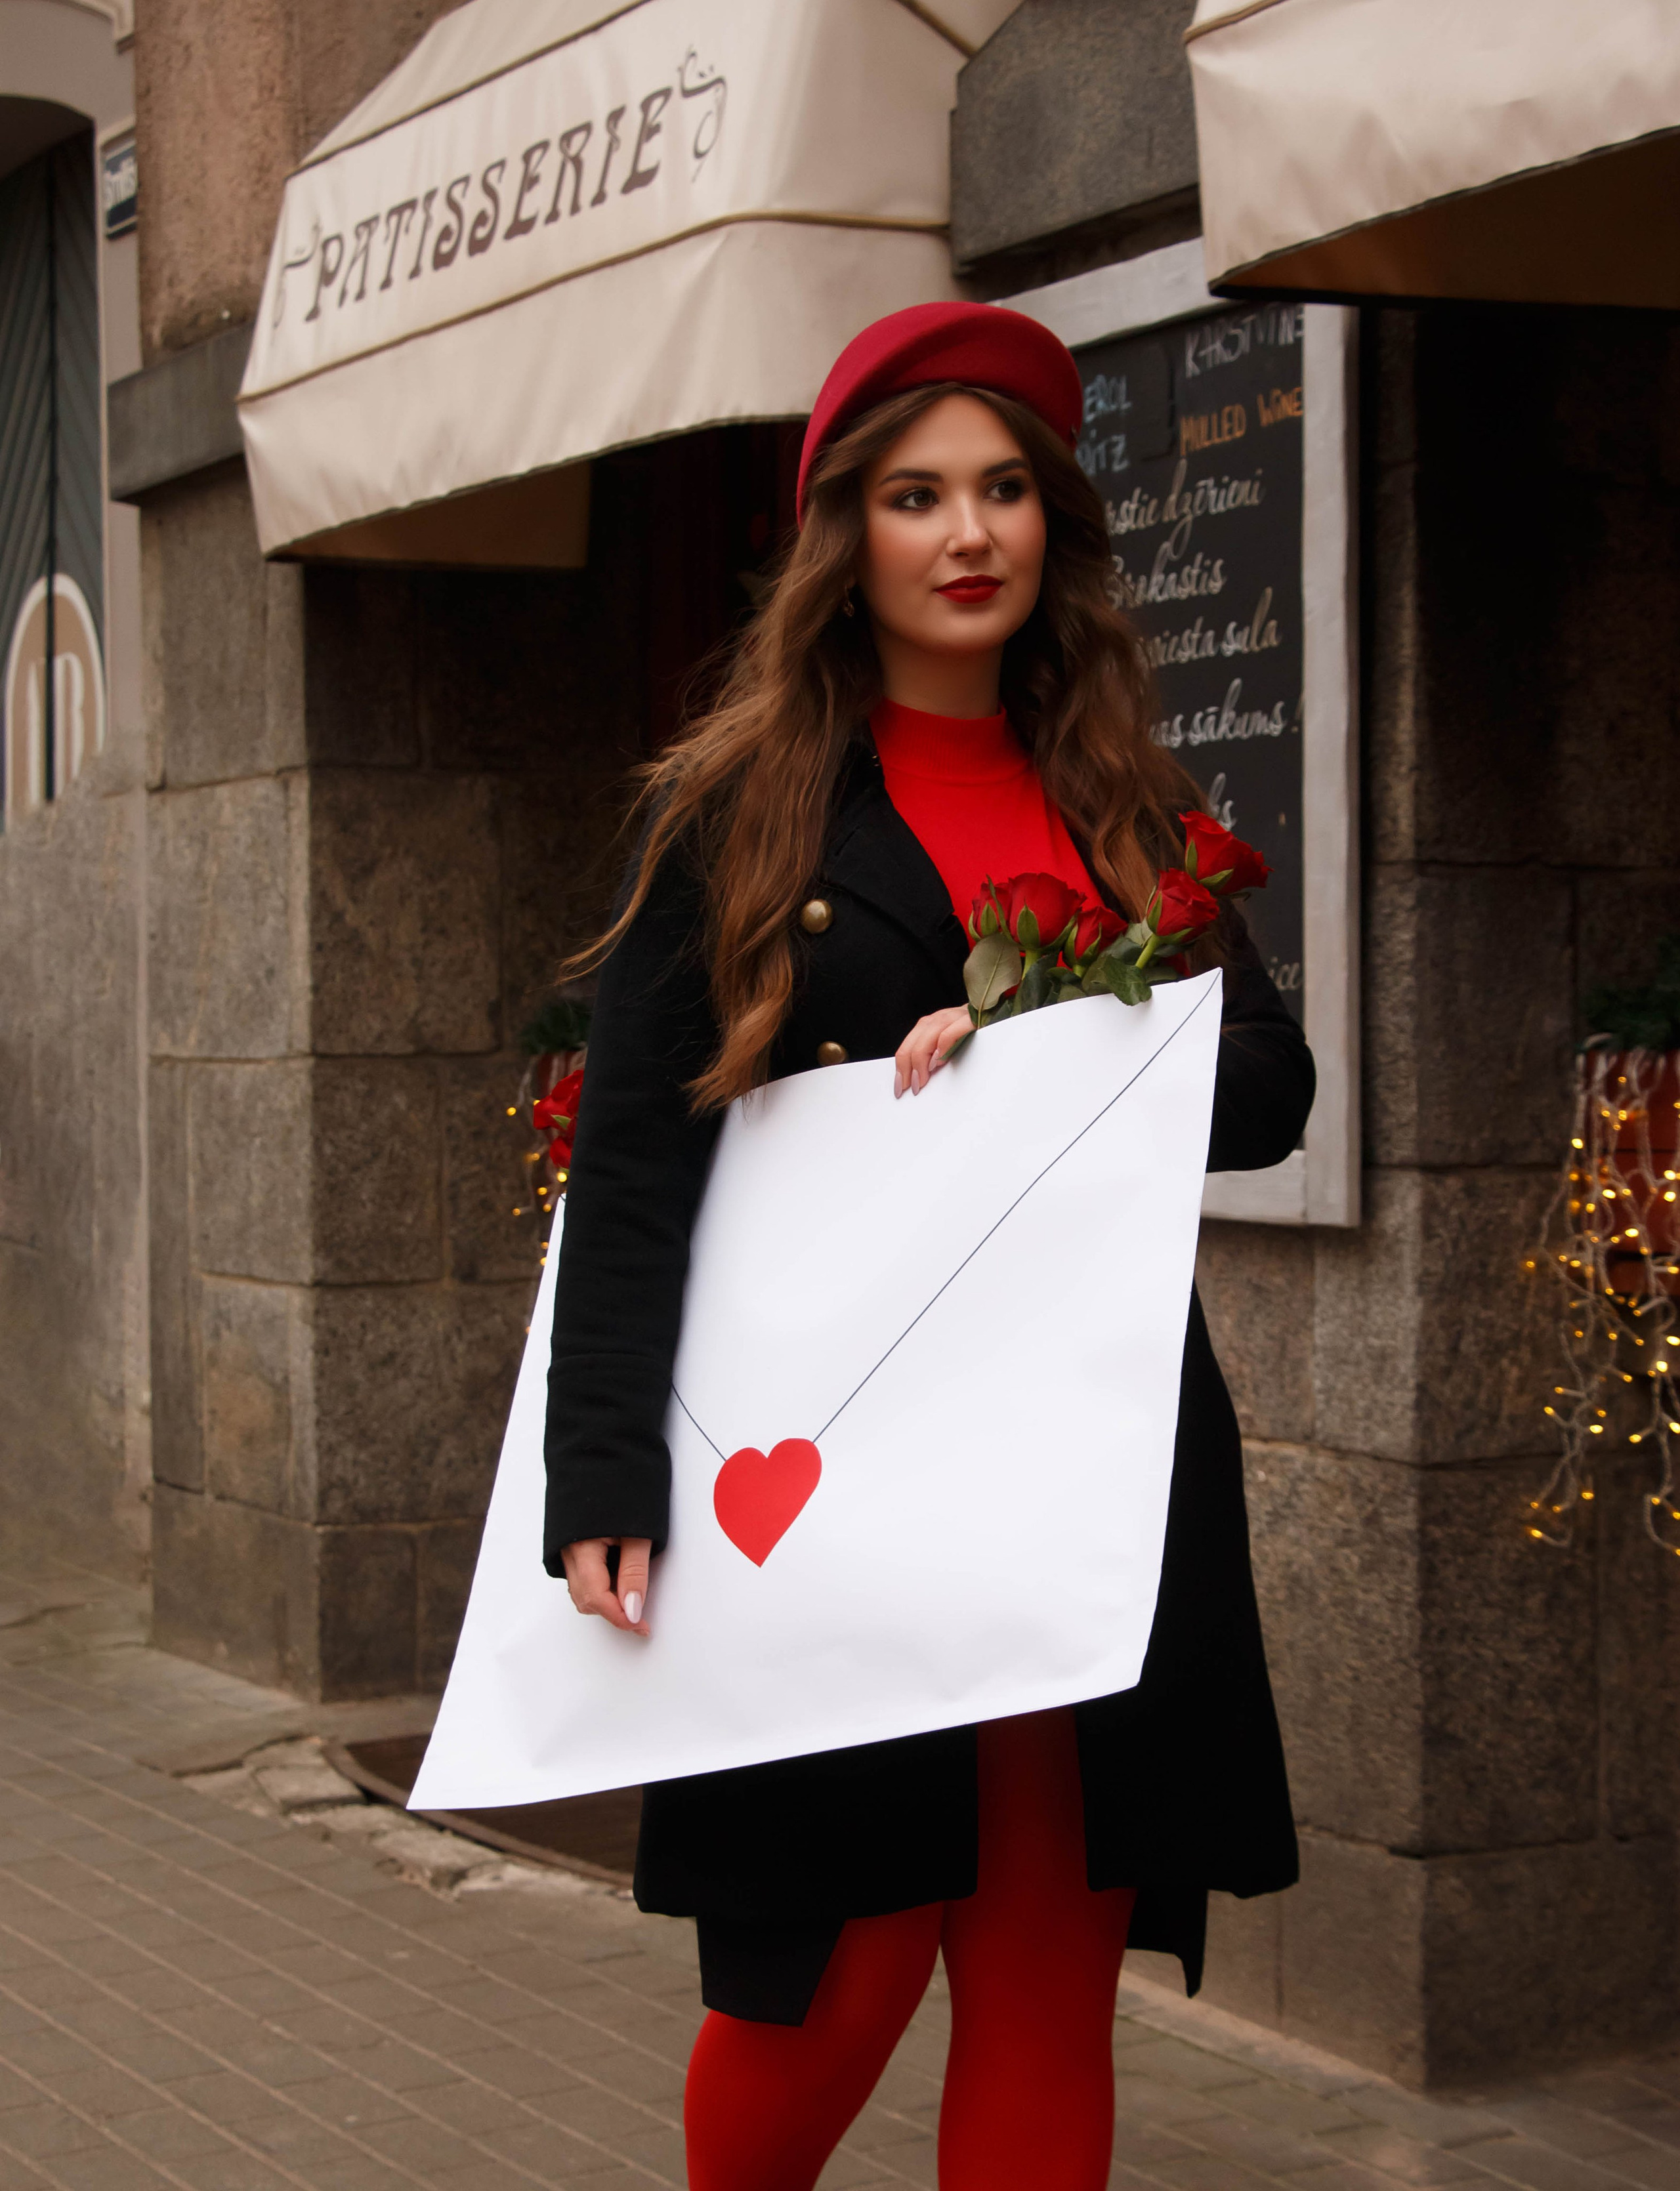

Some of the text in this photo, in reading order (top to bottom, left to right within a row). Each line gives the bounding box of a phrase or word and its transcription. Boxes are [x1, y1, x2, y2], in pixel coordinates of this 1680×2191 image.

[304, 87, 673, 322] PATISSERIE
[1179, 403, 1247, 456] MULLED
[1220, 585, 1283, 657] sula
